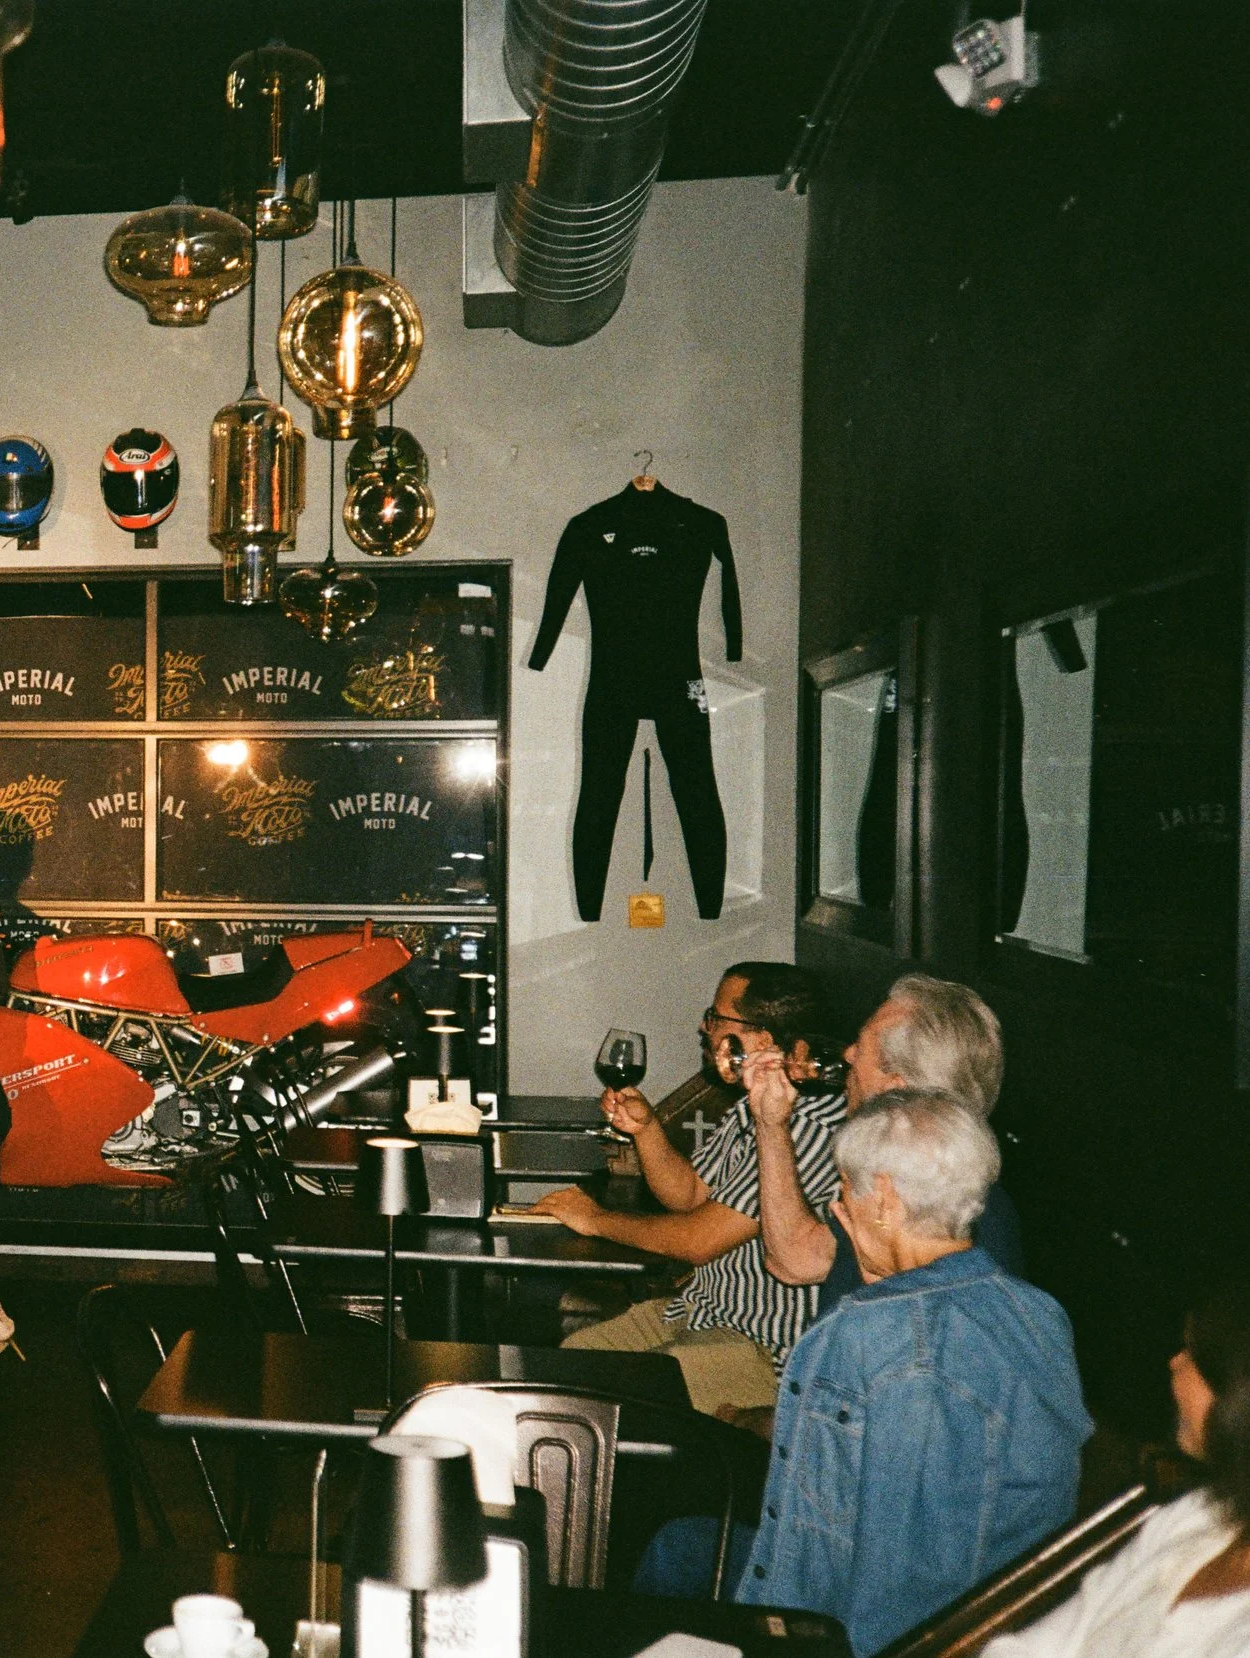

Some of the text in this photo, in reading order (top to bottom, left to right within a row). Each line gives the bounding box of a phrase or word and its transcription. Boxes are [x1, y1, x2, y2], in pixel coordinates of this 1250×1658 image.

[222, 667, 323, 695] IMPERIAL
[11, 694, 42, 706] MOTO
[256, 692, 288, 704] MOTO
[88, 791, 185, 820] IMPEAL
[329, 792, 432, 821] IMPERIAL
[121, 817, 143, 828] MOT
[364, 818, 396, 830] MOTO
[1, 1054, 76, 1086] ERSPORT
